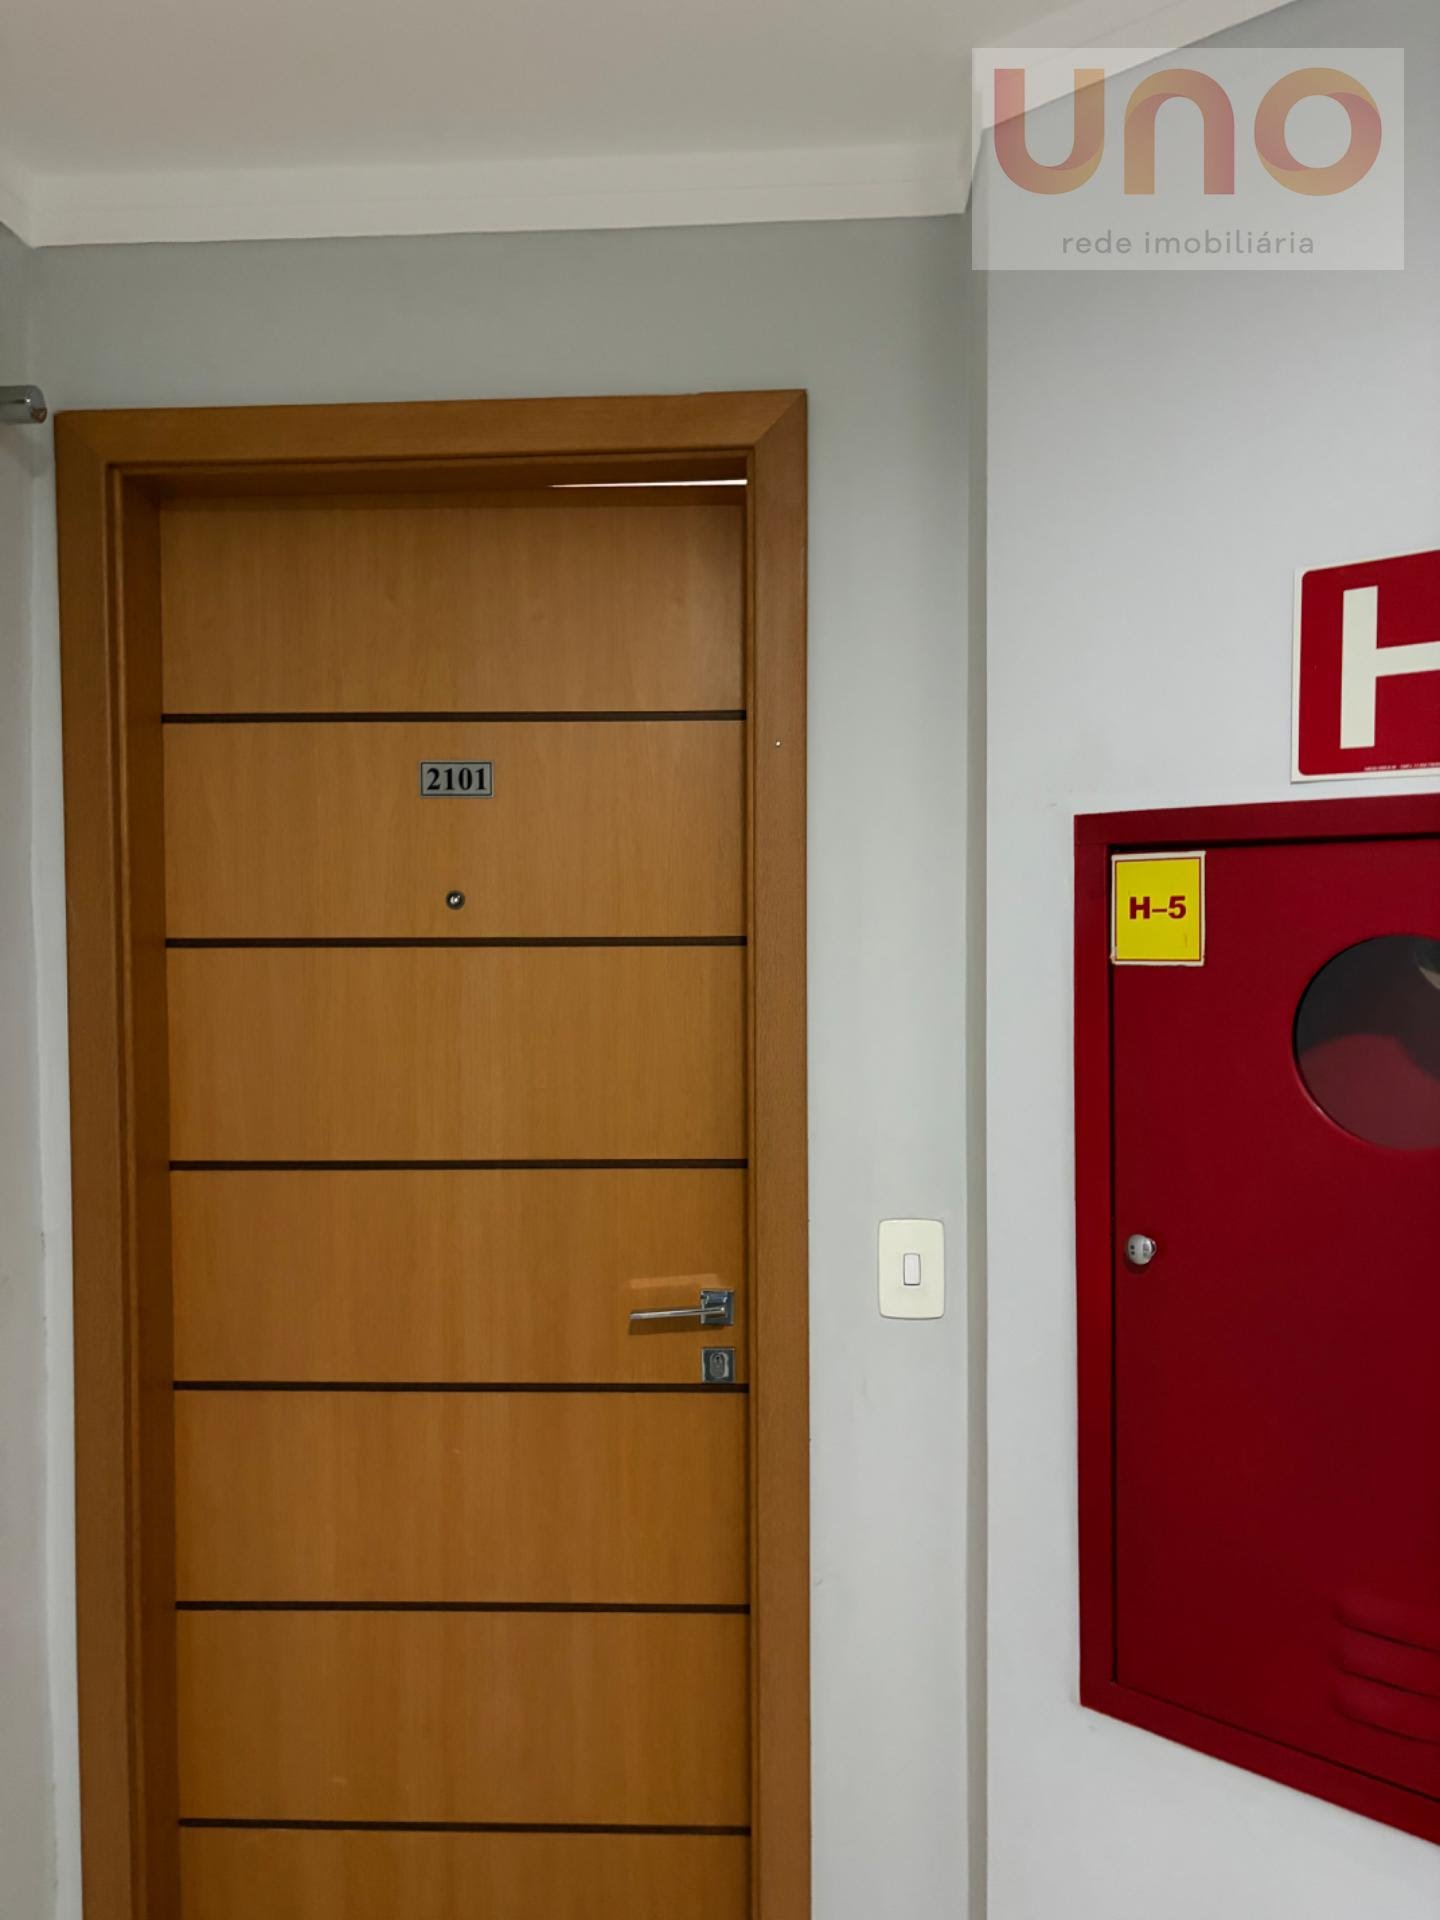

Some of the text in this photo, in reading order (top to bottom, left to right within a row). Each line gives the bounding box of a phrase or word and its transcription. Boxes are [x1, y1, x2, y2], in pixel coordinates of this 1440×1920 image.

[1340, 585, 1440, 749] H
[426, 767, 488, 791] 2101
[1129, 895, 1187, 919] H-5
